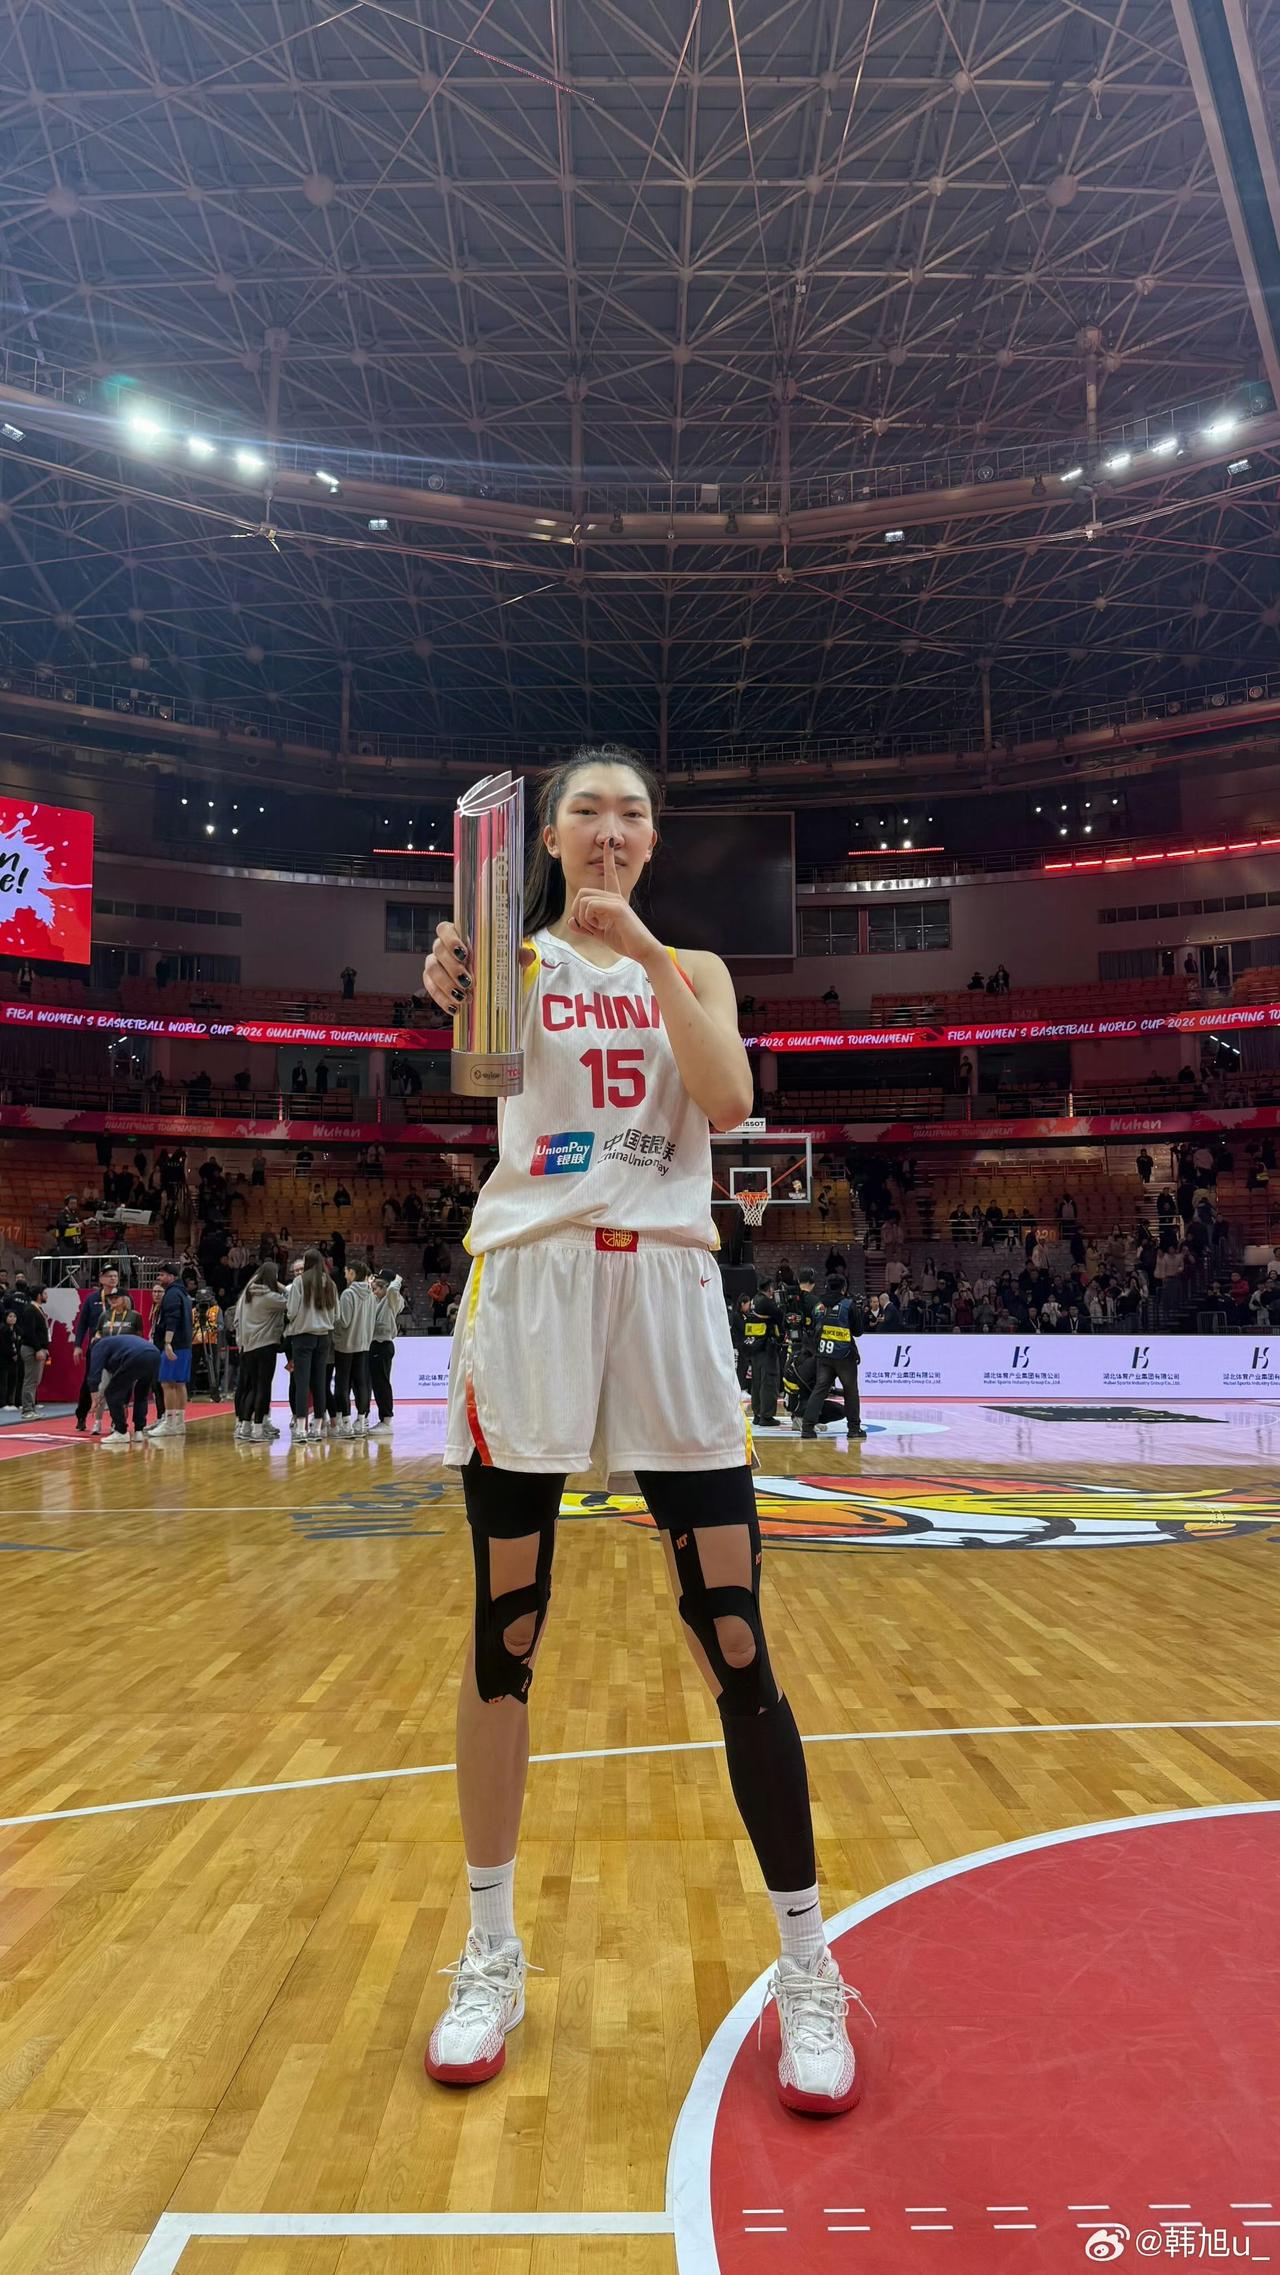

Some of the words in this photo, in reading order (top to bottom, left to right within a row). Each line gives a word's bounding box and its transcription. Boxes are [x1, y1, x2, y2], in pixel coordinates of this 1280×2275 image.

[6, 1007, 33, 1020] FIBA
[37, 1011, 94, 1026] WOMEN'S
[97, 1016, 164, 1031] BASKETBALL
[168, 1022, 206, 1034] WORLD
[210, 1024, 234, 1035] CUP
[236, 1026, 262, 1037] 2026
[266, 1027, 326, 1040] QUALIFYING
[330, 1030, 398, 1043] TOURNAMENT
[948, 1029, 972, 1041] FIBA
[975, 1027, 1027, 1040] WOMEN'S
[1031, 1023, 1095, 1037] BASKETBALL
[1099, 1021, 1137, 1033] WORLD
[1141, 1018, 1165, 1030] CUP
[1168, 1017, 1195, 1028] 2026
[1200, 1010, 1265, 1026] QUALIFYING
[742, 1037, 757, 1048] UP
[760, 1036, 784, 1047] 2026
[787, 1035, 844, 1047] QUALIFYING
[848, 1032, 915, 1045] TOURNAMENT
[579, 1049, 645, 1108] 15
[312, 1124, 360, 1138] Wuhan
[1110, 1118, 1161, 1132] Wuhan
[536, 1141, 590, 1158] UnionPay
[820, 1339, 834, 1354] 99
